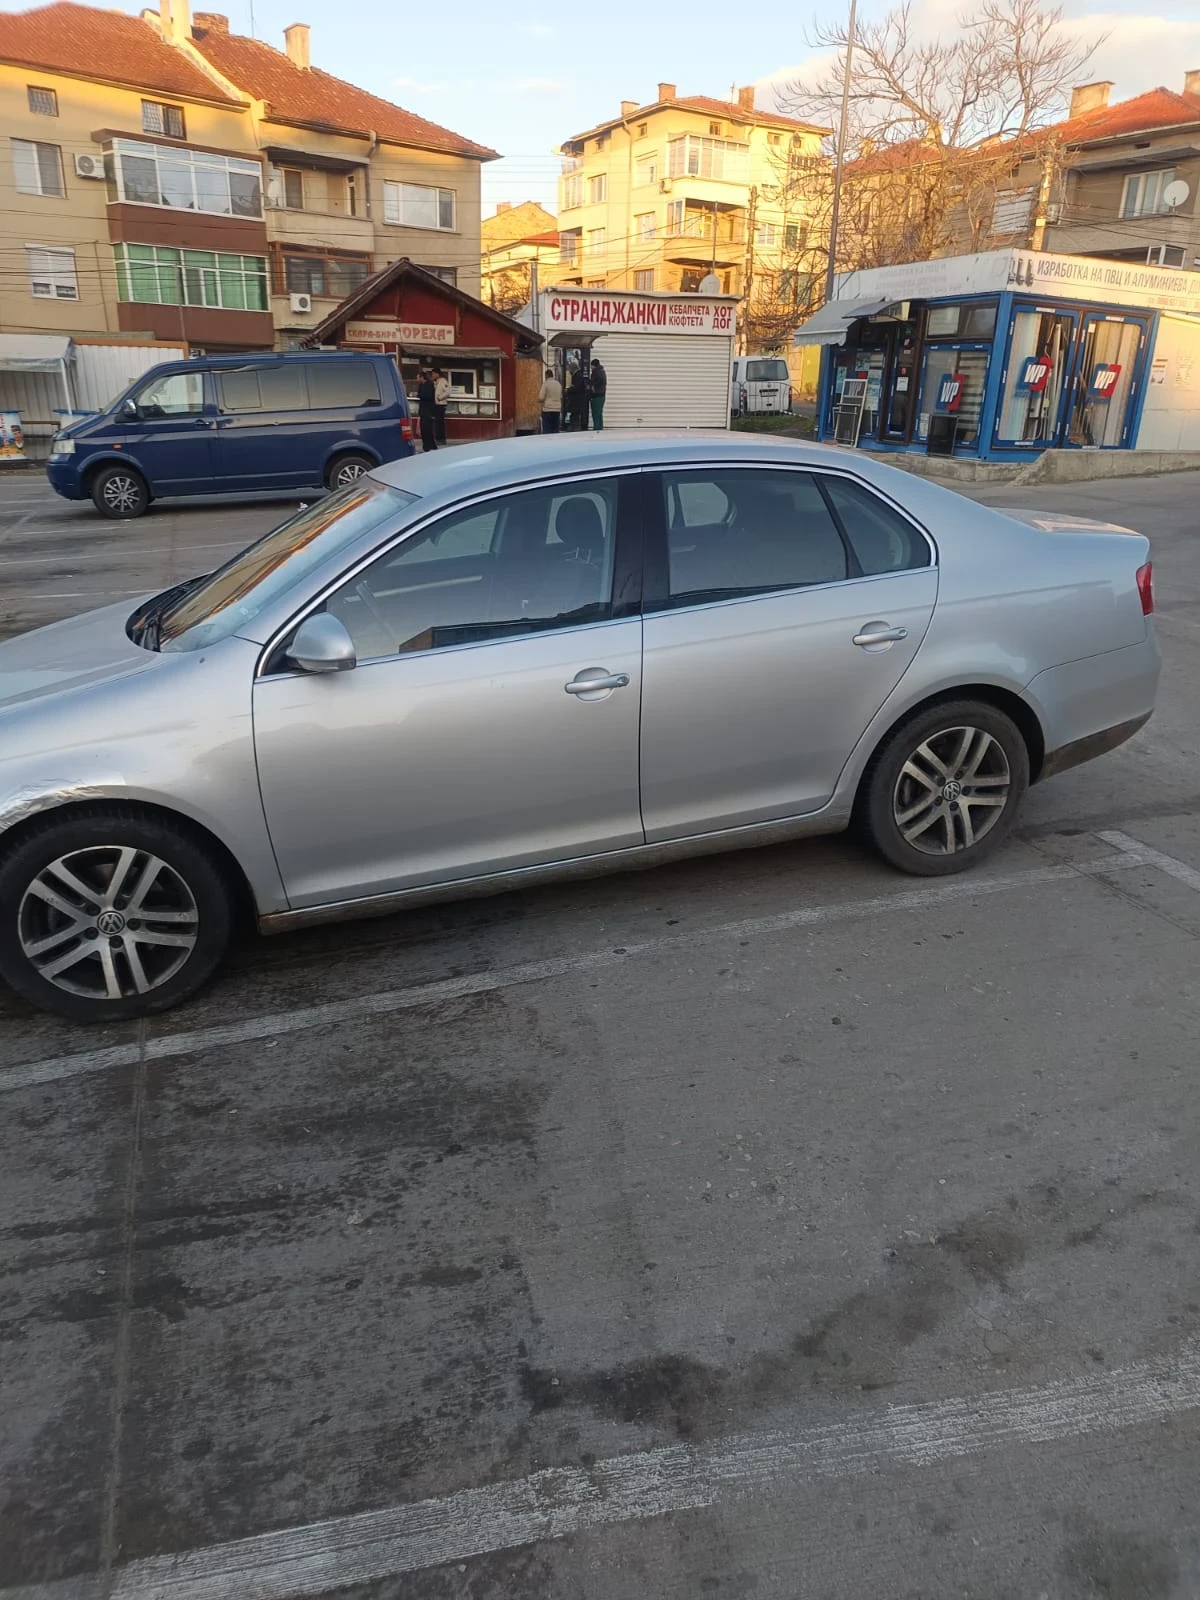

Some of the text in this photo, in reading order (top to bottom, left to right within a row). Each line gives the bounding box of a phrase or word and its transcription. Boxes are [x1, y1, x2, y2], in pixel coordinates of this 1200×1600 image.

[1037, 260, 1088, 280] ИЗРАБОТКА
[1090, 266, 1103, 281] НА
[1104, 268, 1122, 287] ПВЦ
[1123, 271, 1131, 285] И
[1132, 271, 1188, 293] АЛУМИНИЕВА
[551, 297, 667, 326] СТРАНДЖАНКИ
[669, 303, 710, 316] КЕБАПЧЕТА
[713, 306, 733, 318] ХОТ
[668, 315, 704, 327] КЮФТЕТА
[712, 317, 732, 330] ДОГ
[1023, 364, 1047, 383] WP
[1093, 370, 1116, 389] WP
[940, 382, 960, 402] WP
